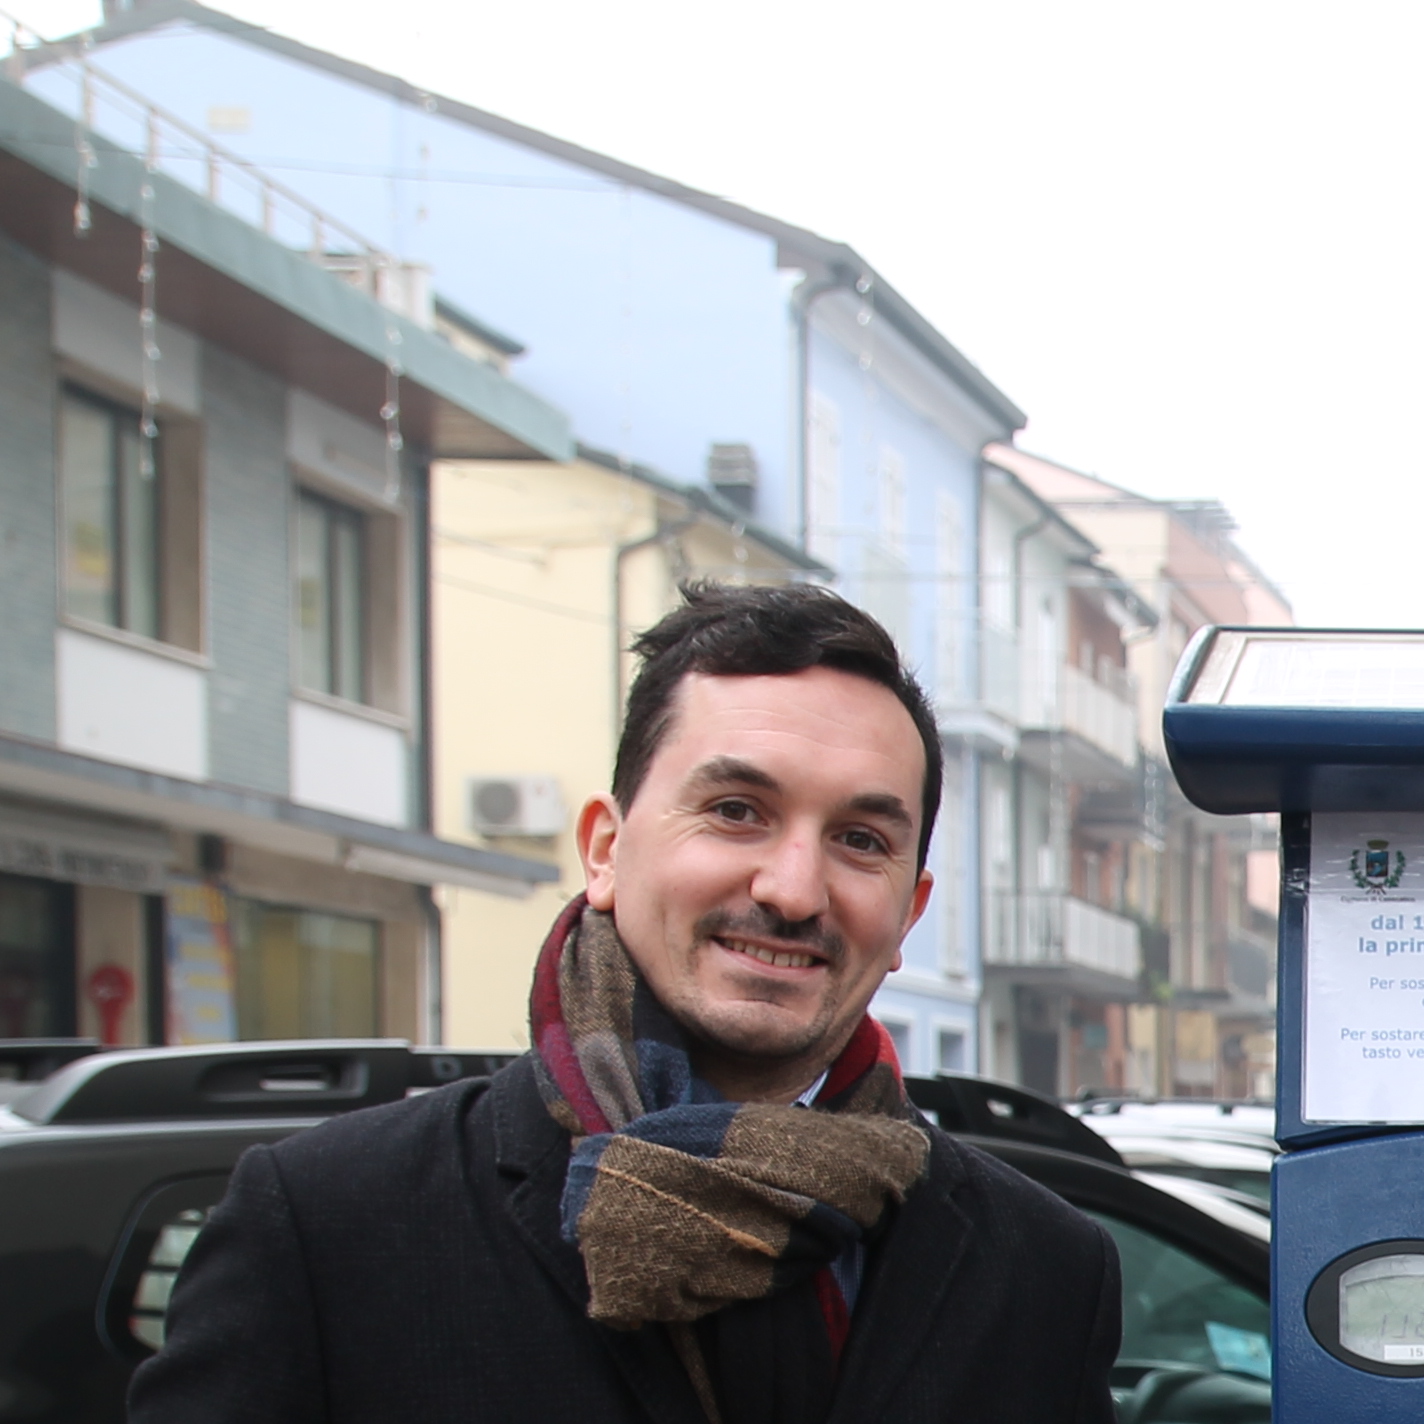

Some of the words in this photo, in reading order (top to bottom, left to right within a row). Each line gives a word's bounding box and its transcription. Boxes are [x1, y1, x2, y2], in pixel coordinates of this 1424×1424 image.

[1371, 915, 1404, 931] dal
[1359, 937, 1378, 953] la
[1370, 977, 1395, 990] Per
[1340, 1028, 1366, 1041] Per
[1362, 1047, 1402, 1059] tasto
[1409, 1348, 1424, 1358] 15
